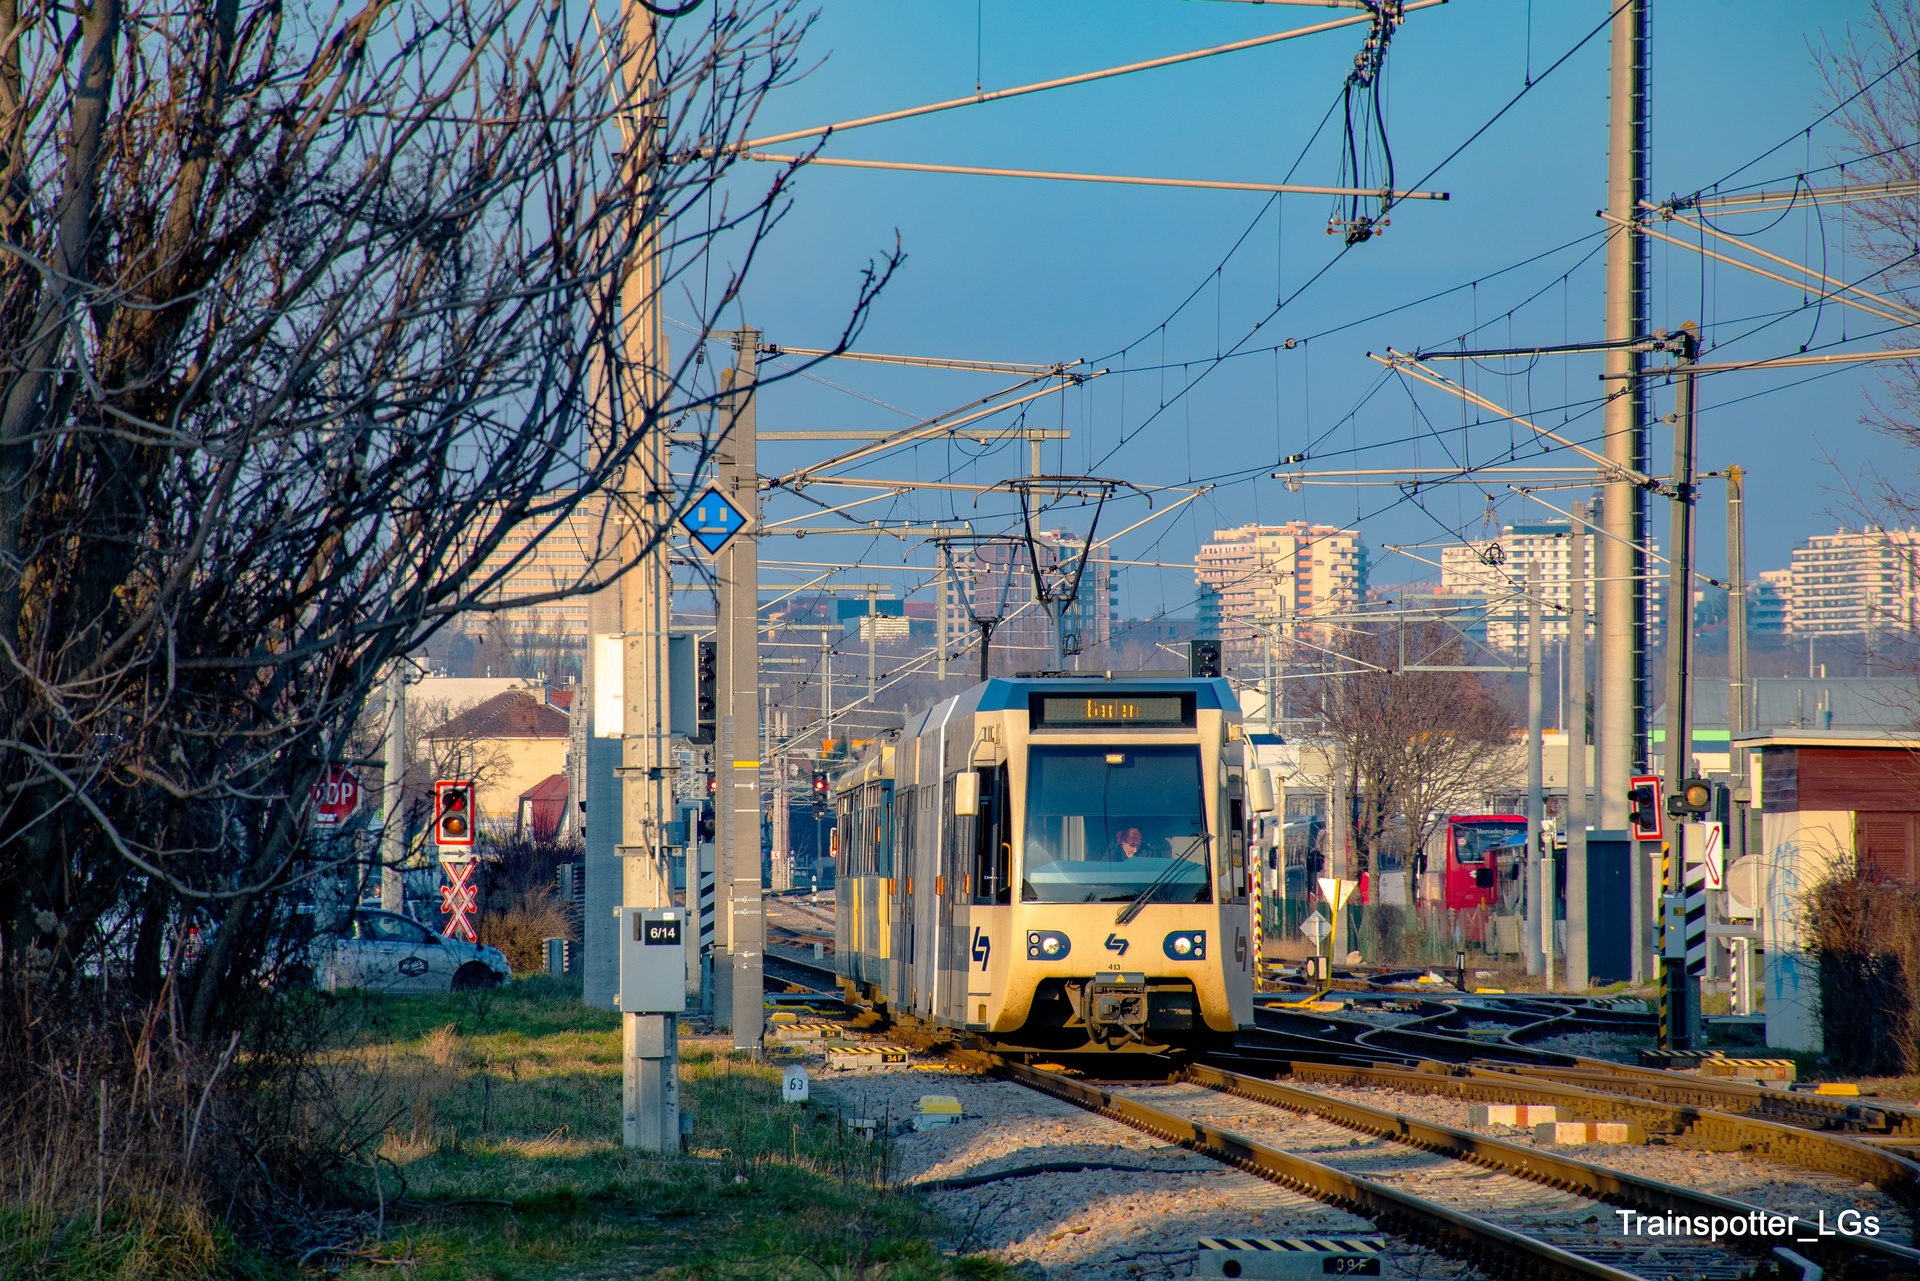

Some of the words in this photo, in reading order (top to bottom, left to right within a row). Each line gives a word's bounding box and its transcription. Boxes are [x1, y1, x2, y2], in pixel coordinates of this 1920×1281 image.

[650, 927, 676, 939] 6/14
[1108, 963, 1121, 971] 413
[790, 1077, 804, 1091] 63
